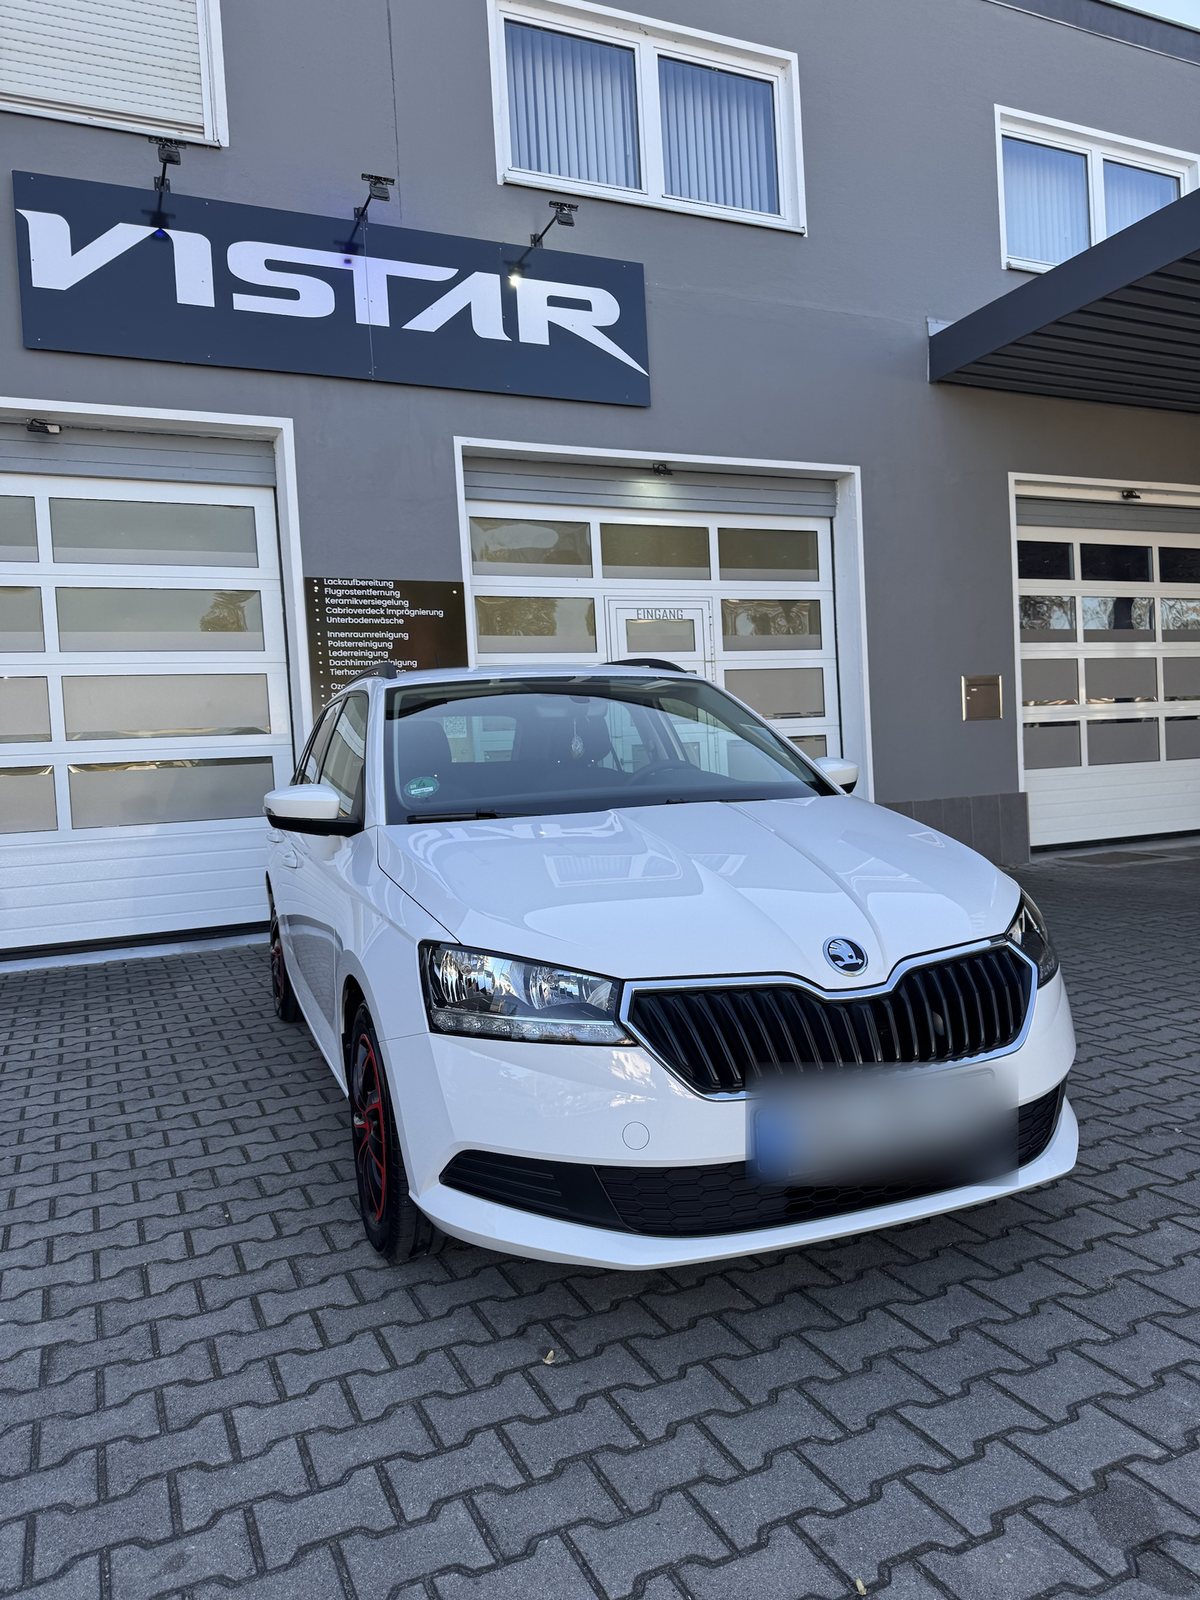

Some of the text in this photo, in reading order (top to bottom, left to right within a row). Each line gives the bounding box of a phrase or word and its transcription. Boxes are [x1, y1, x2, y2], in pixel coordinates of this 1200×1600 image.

[15, 208, 650, 376] VISTAR
[323, 578, 394, 588] Lackaufbereitung
[324, 587, 400, 598] Flugrostentfernung
[325, 597, 409, 607] Keramikversiegelung
[325, 606, 444, 618] Cabrioverdeck Imprägnierung
[636, 608, 684, 620] EINGANG
[326, 616, 405, 624] Unterbodenwäsche
[327, 631, 409, 640] Innenraumreinigung
[328, 640, 393, 649] Polsterreinigung
[328, 649, 389, 659] Lederreinigung
